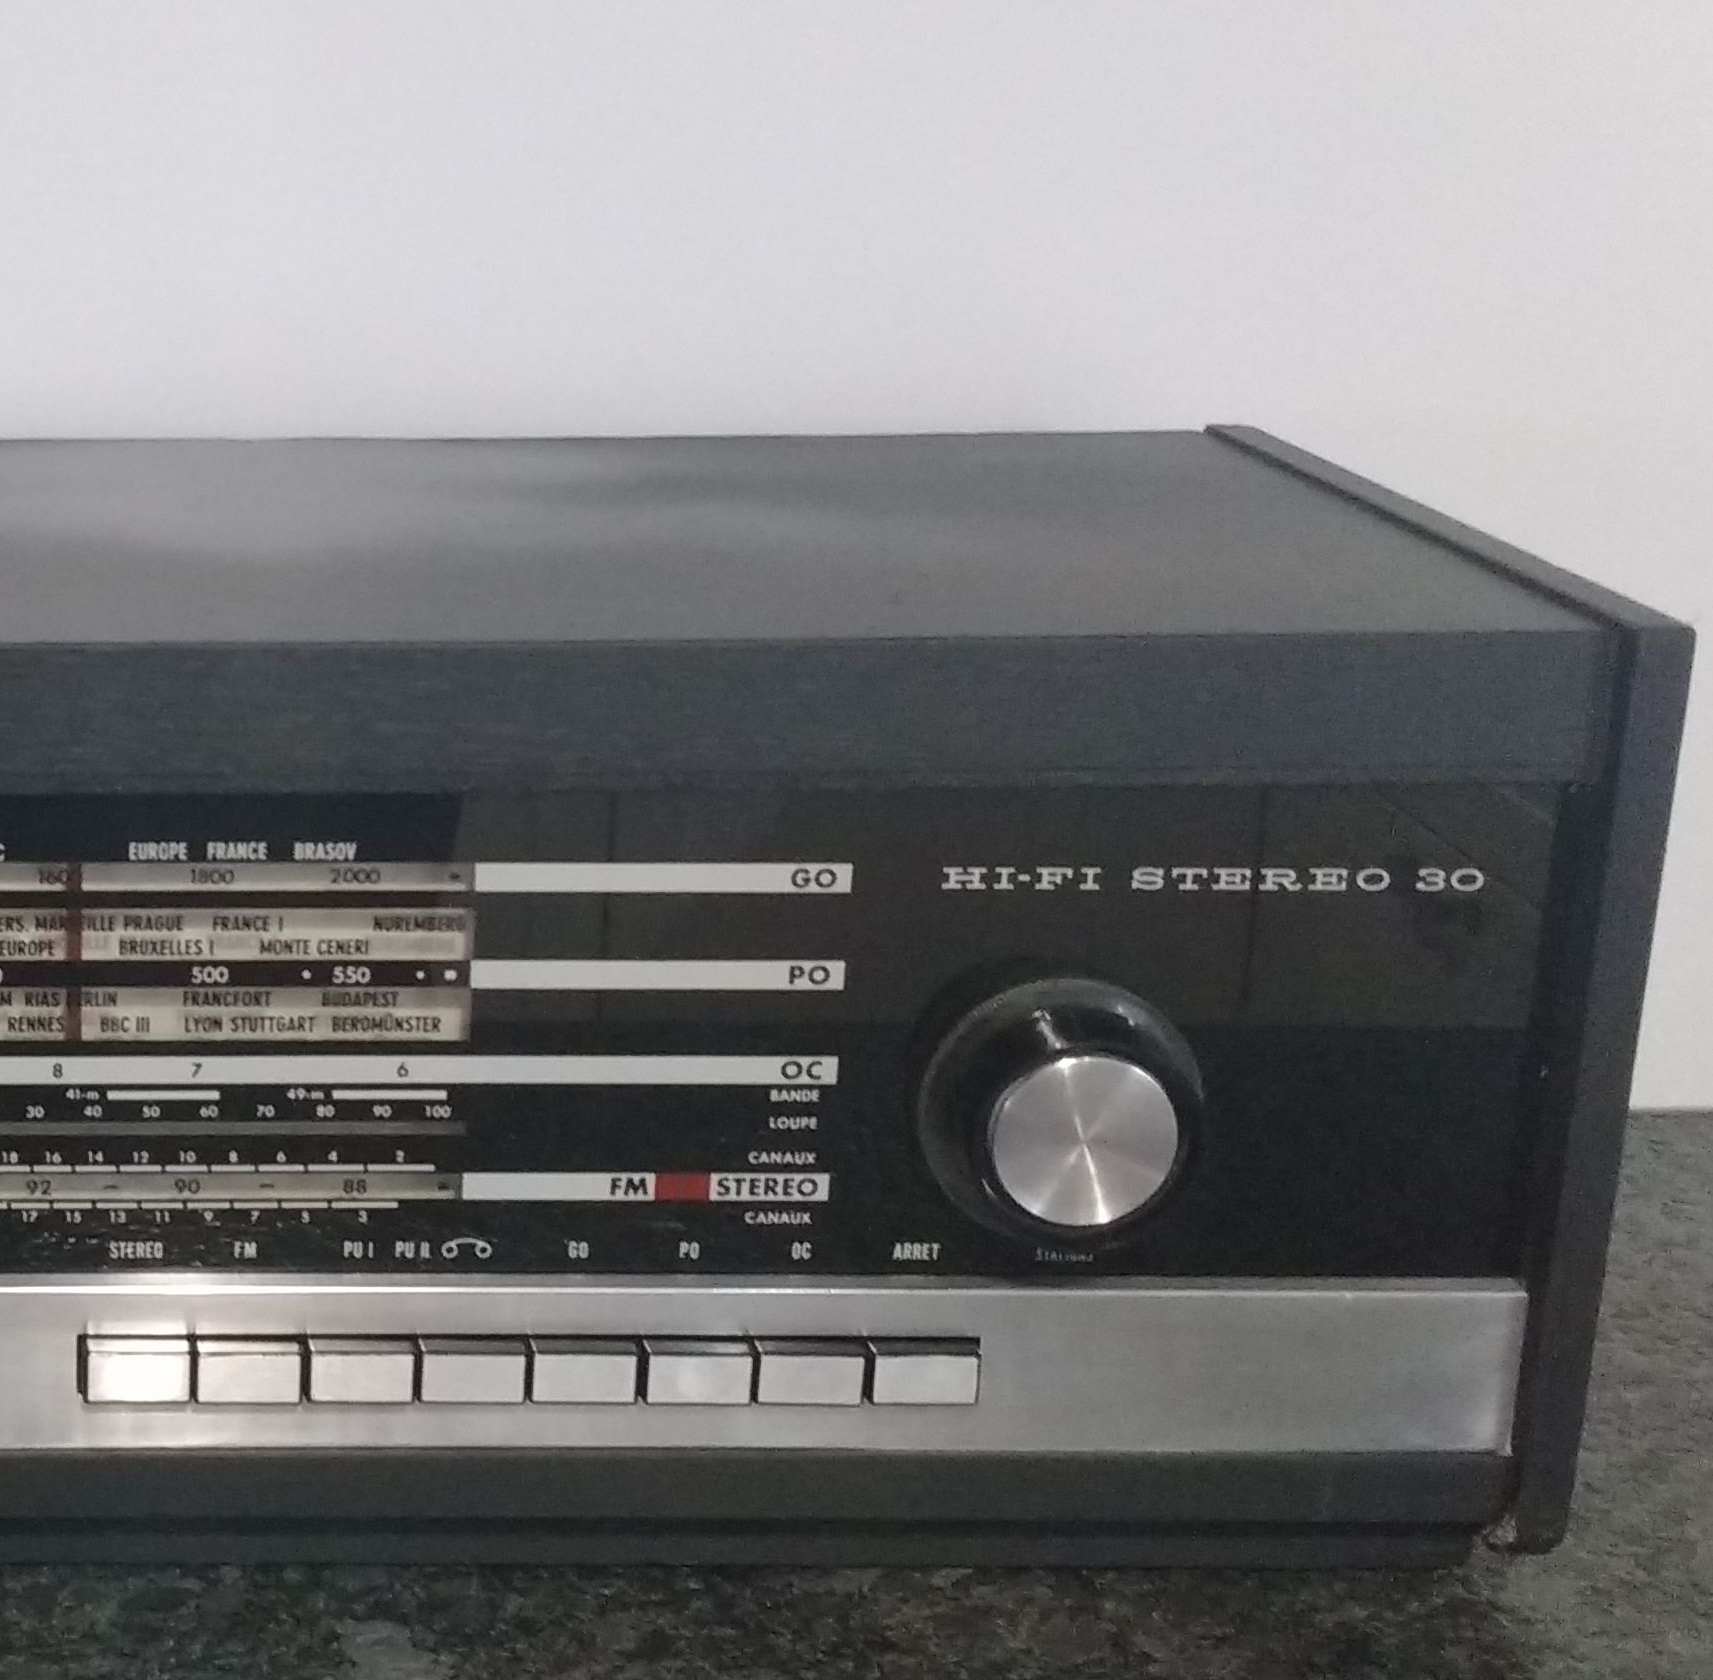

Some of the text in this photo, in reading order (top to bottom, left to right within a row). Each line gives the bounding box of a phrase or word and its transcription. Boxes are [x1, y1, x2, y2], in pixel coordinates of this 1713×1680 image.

[129, 842, 187, 860] EUROPE
[207, 842, 267, 859] FRANCE
[294, 843, 356, 860] BRASOV
[191, 869, 234, 885] 1800
[331, 868, 381, 884] 2000
[791, 869, 837, 888] GO
[942, 867, 1484, 891] HI-FI STEREO 30
[124, 915, 183, 932] PRAGUE
[213, 916, 283, 932] FRANCE I
[0, 938, 55, 956] EUROPE
[119, 938, 214, 956] BRUXELLES I
[259, 939, 369, 955] MONTE CENERI
[192, 966, 229, 983] 500
[333, 966, 370, 983] 550
[789, 966, 830, 985] PO
[25, 992, 60, 1007] RIAS
[183, 991, 271, 1007] FRANCFORT
[322, 990, 398, 1007] BUDAPEST
[8, 1016, 65, 1034] RENNES
[99, 1014, 150, 1033] BBC III
[185, 1017, 223, 1033] LYON
[230, 1013, 316, 1032] STUTTGART
[53, 1063, 63, 1078] 8
[192, 1063, 202, 1077] 7
[397, 1063, 408, 1077] 6
[781, 1061, 822, 1080] OC
[770, 1089, 819, 1102] BANDE
[200, 1105, 218, 1117] 60
[257, 1105, 275, 1117] 70
[426, 1105, 451, 1118] 100
[770, 1117, 817, 1129] LOUPE
[749, 1152, 816, 1164] CANAUX
[26, 1180, 52, 1196] 92
[175, 1179, 200, 1194] 90
[343, 1179, 367, 1195] 88
[610, 1178, 648, 1195] FM
[717, 1178, 818, 1196] STEREO
[745, 1212, 811, 1224] CANAUX
[110, 1242, 163, 1258] STEREO
[234, 1242, 257, 1258] FM
[344, 1241, 373, 1258] PU I
[395, 1241, 431, 1258] PU II
[568, 1241, 589, 1258] GO
[679, 1242, 699, 1259] PO
[792, 1242, 811, 1259] OC
[893, 1243, 940, 1260] ARRET
